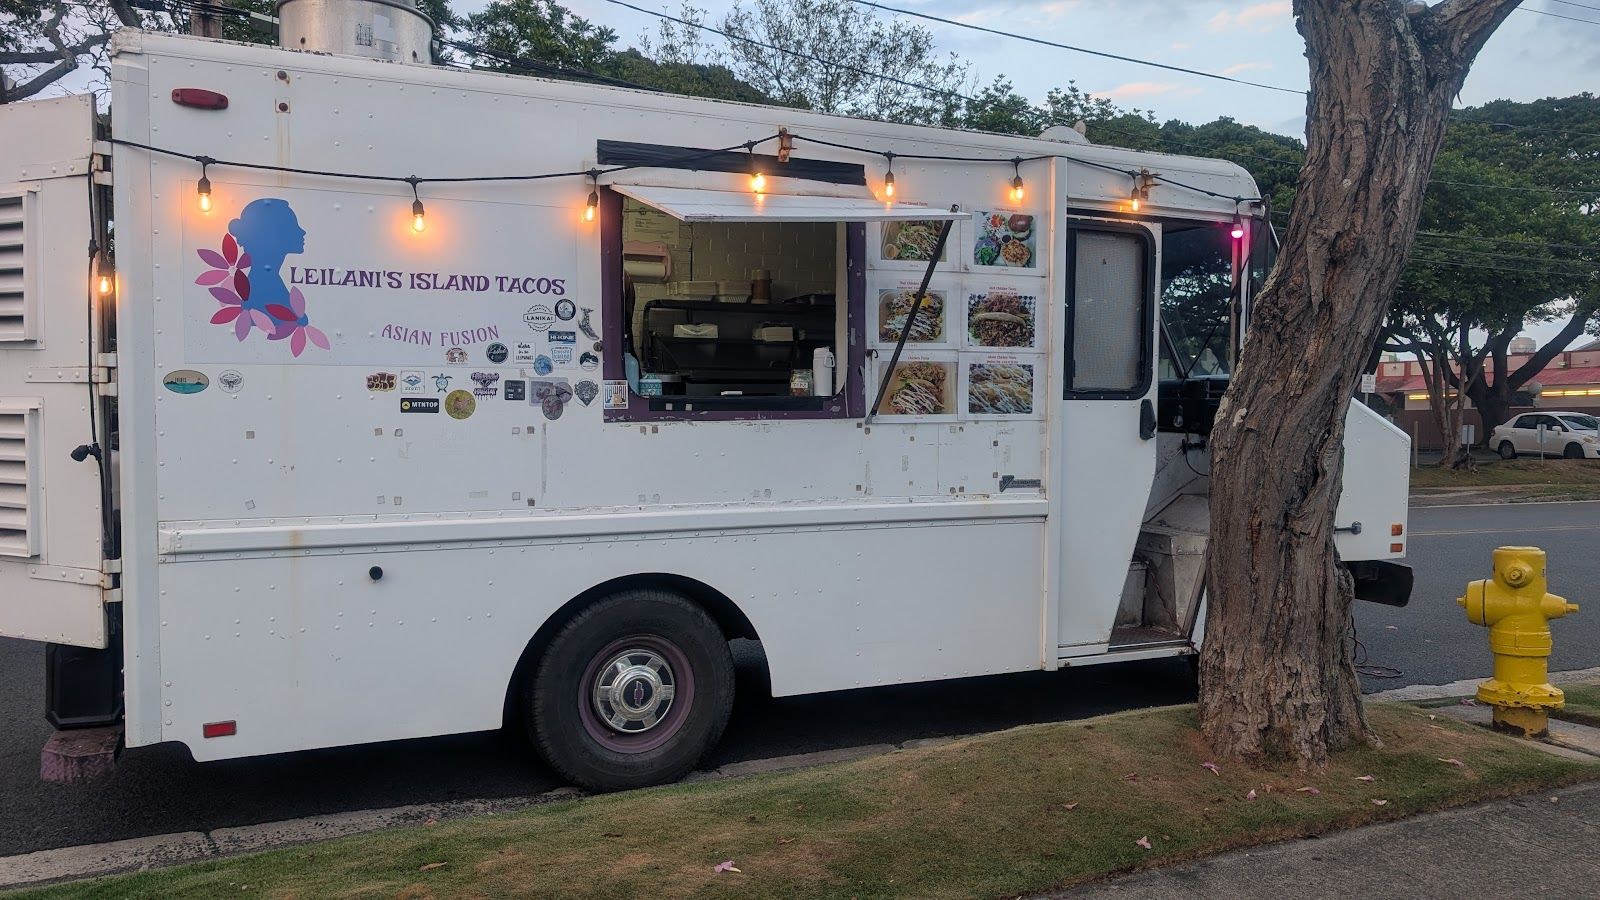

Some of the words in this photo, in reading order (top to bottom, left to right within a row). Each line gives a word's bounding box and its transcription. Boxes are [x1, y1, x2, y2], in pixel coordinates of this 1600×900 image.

[290, 266, 403, 290] LEILANI'S
[409, 272, 491, 292] ISLAND
[495, 275, 566, 296] TACOS
[381, 323, 432, 347] ASIAN
[440, 324, 501, 347] FUSION
